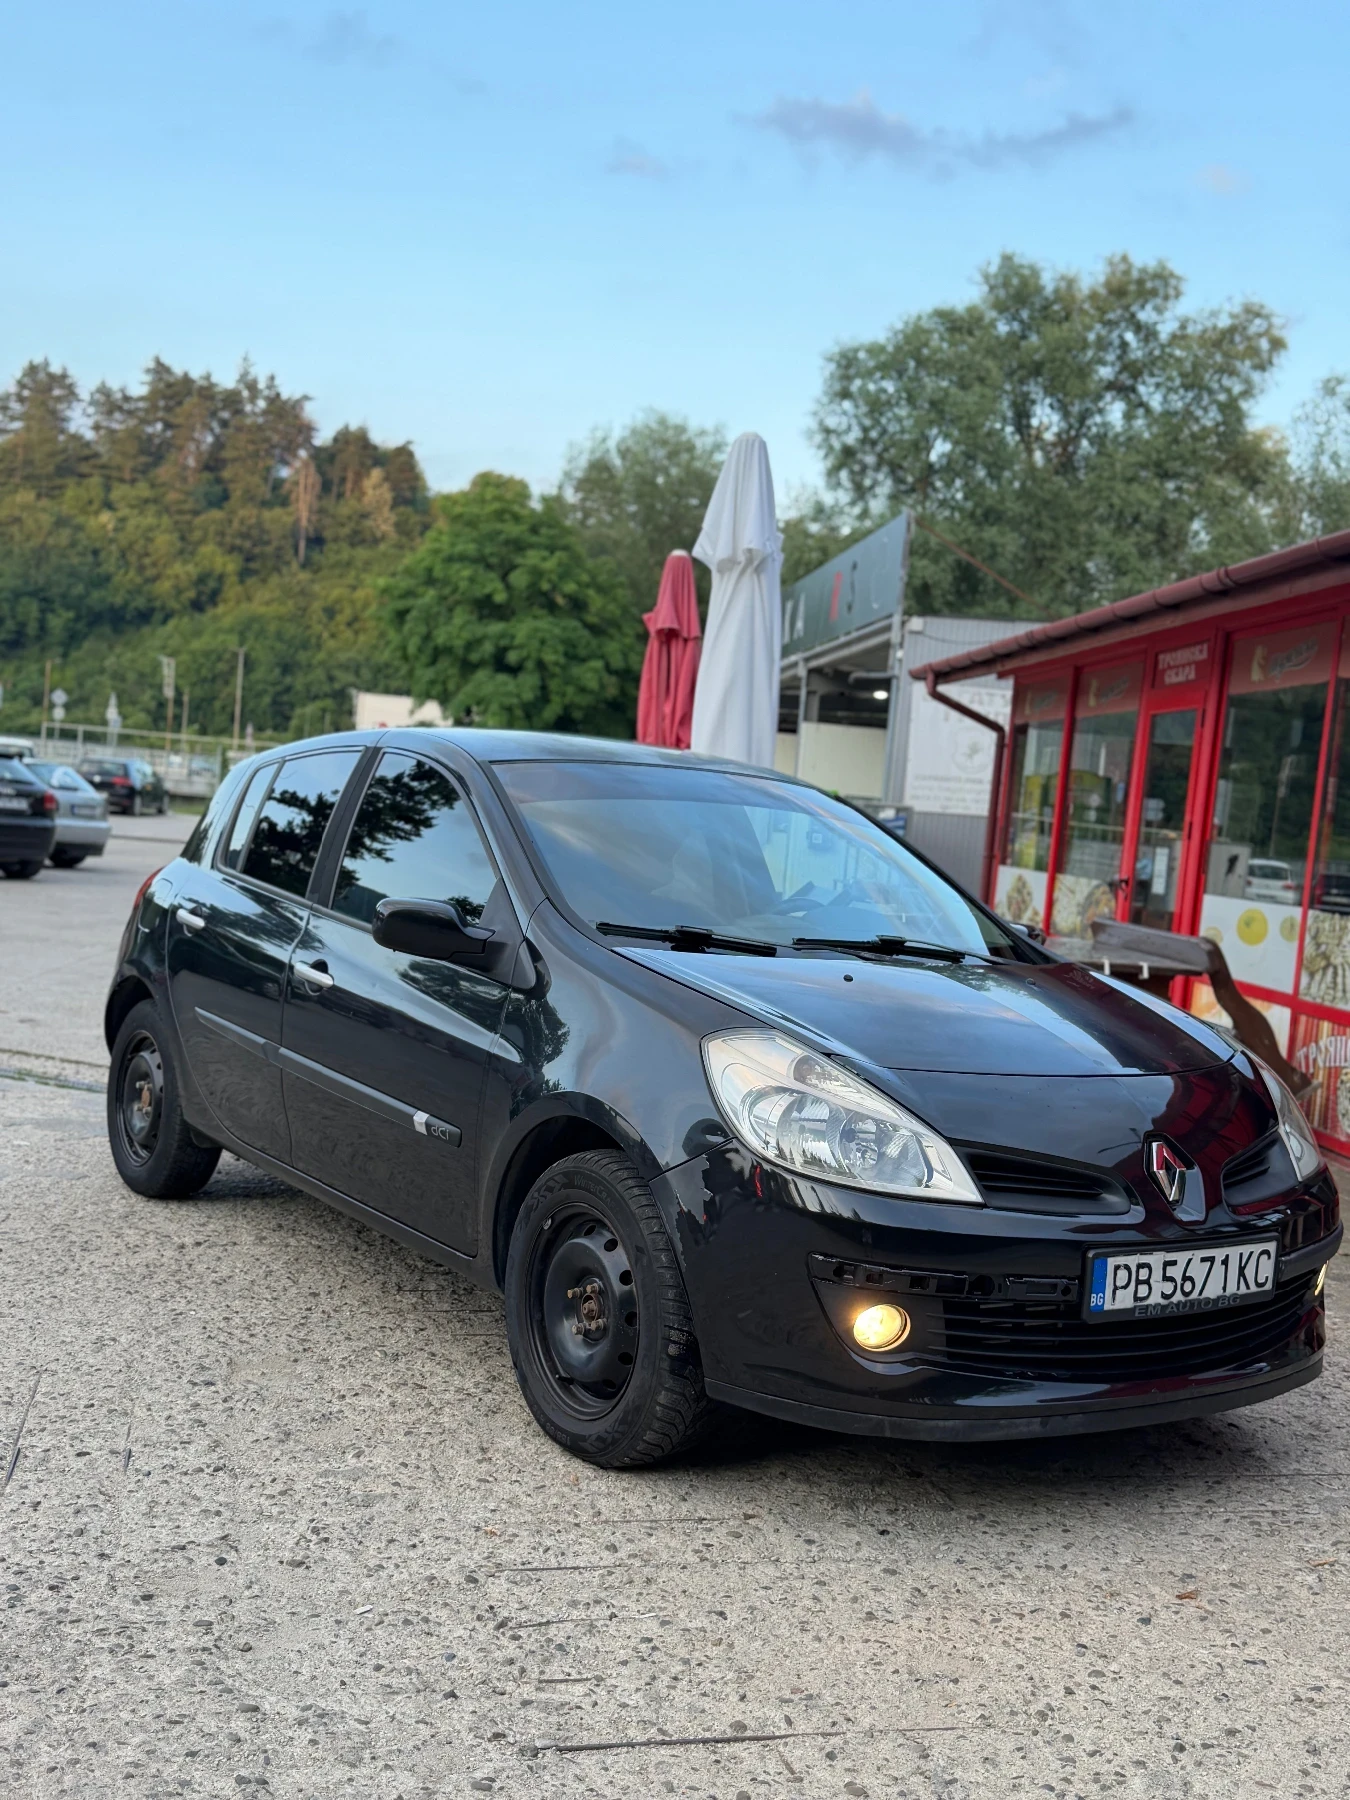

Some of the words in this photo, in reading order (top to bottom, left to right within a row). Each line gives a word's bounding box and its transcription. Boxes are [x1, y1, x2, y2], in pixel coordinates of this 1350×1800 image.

[1090, 1292, 1104, 1307] BG
[1134, 1304, 1162, 1317] EM
[1166, 1298, 1213, 1314] AUTO
[1218, 1293, 1241, 1307] BG
